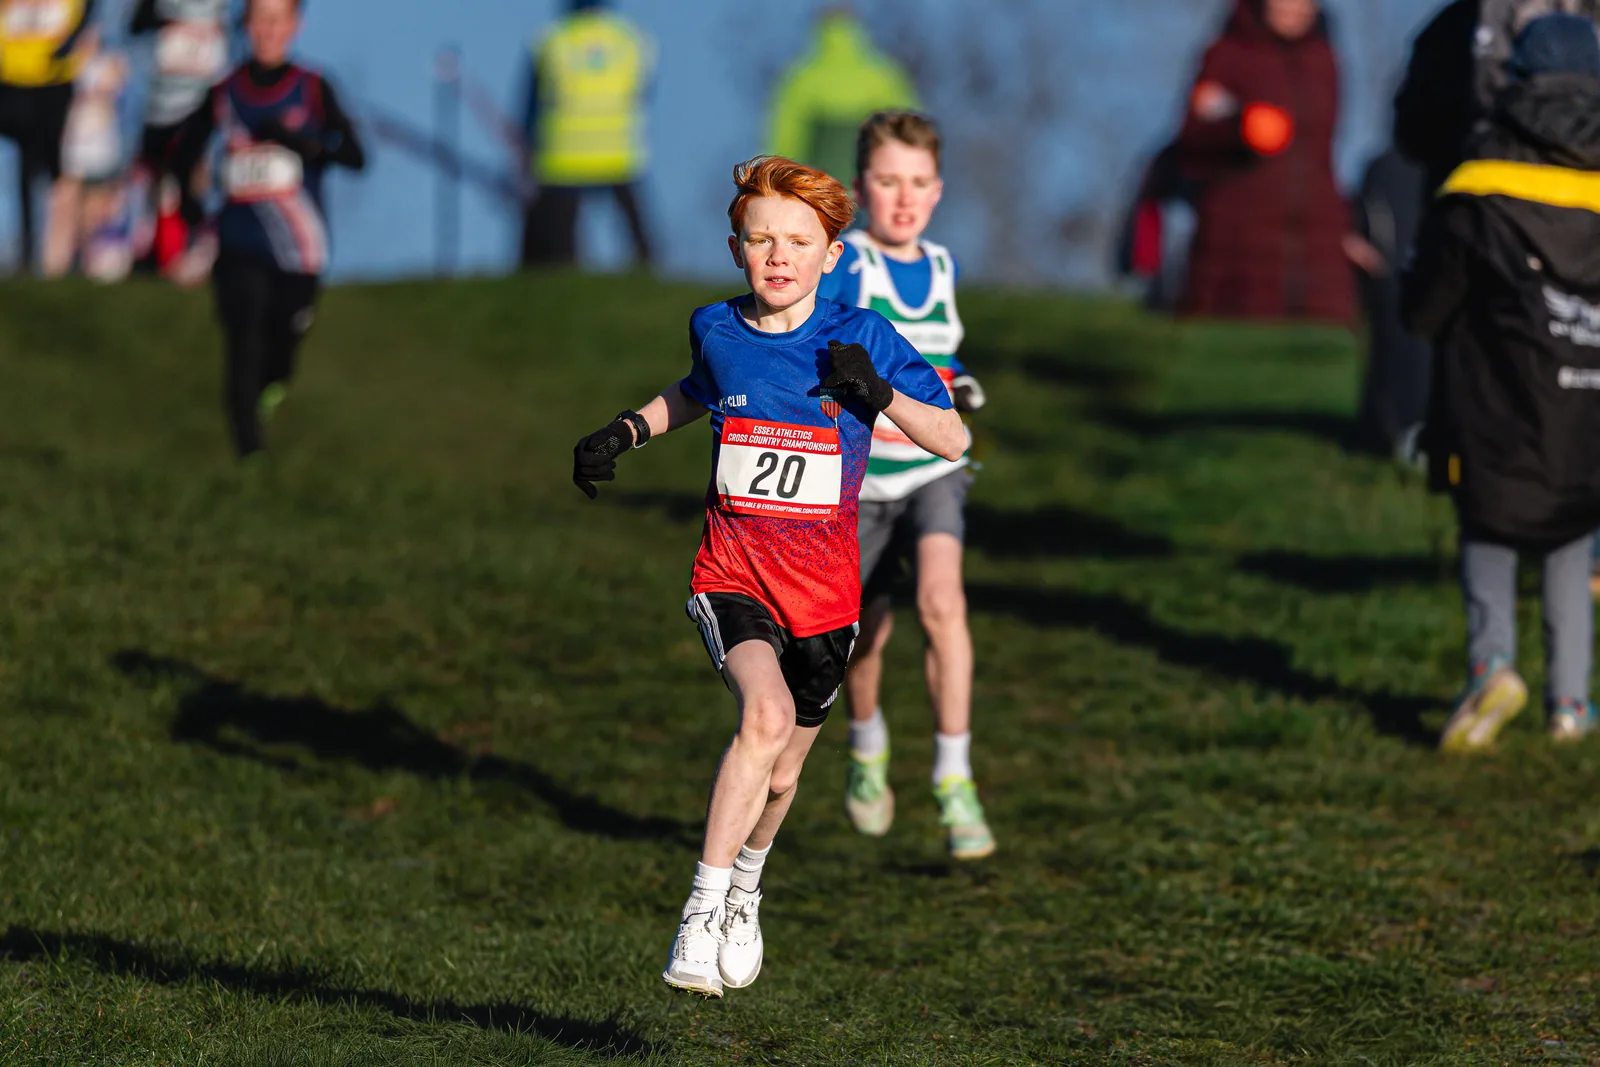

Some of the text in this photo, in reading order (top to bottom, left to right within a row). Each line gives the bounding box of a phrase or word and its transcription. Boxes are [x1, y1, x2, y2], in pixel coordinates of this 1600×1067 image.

[753, 425, 813, 440] ESSEX ATHLETICS
[728, 433, 838, 452] CROSS COUNTRY CHAMPIONSHIPS
[748, 451, 806, 499] 20
[734, 500, 757, 508] AVAILABLE
